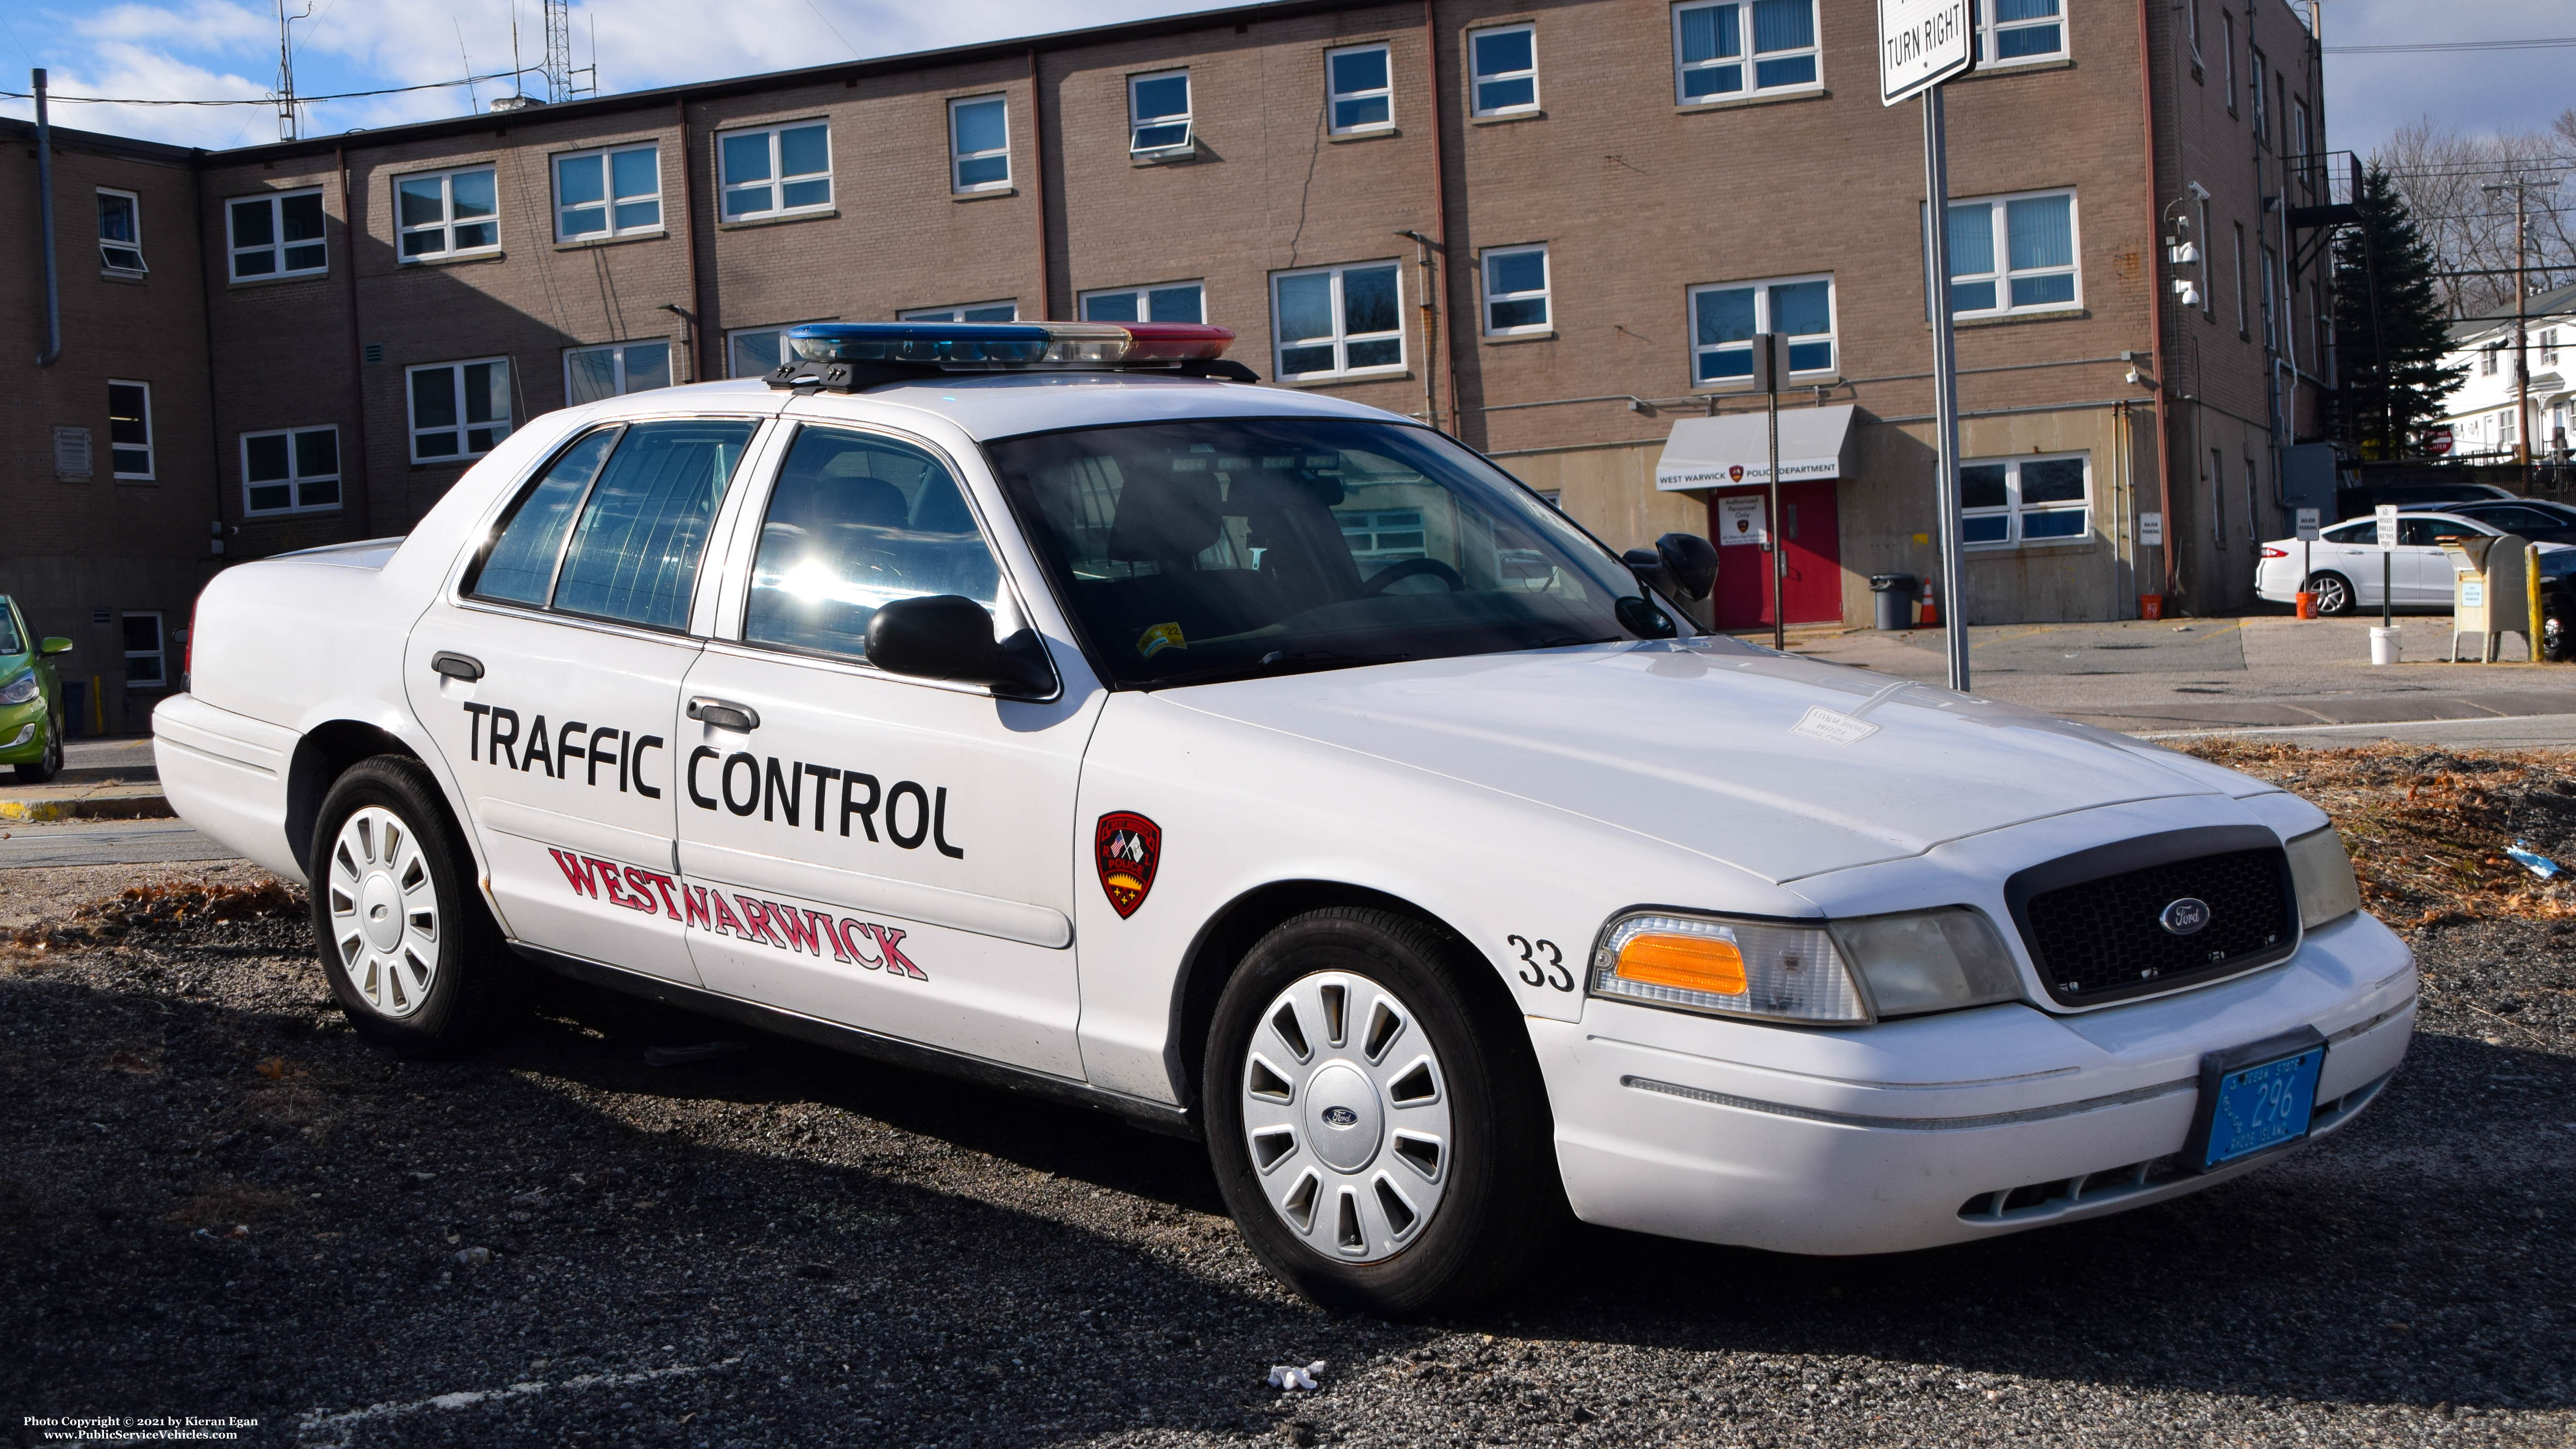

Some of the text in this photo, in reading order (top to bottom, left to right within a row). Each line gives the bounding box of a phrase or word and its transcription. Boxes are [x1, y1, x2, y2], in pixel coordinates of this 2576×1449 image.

[1888, 3, 1959, 70] TURN RIGHT
[1660, 463, 1836, 484] WEST WARWICK POLIC DEPARTMENT
[464, 701, 964, 859] TRAFFIC CONTROL
[1108, 859, 1144, 875] POLICE
[548, 847, 683, 922] WEST
[2175, 905, 2199, 926] Ford
[1507, 934, 1575, 992] 33
[2243, 1059, 2300, 1086] OCEAN STATE
[2251, 1074, 2296, 1128] 296
[1332, 1111, 1351, 1122] Ford
[2231, 1122, 2287, 1150] RHODE ISLAND
